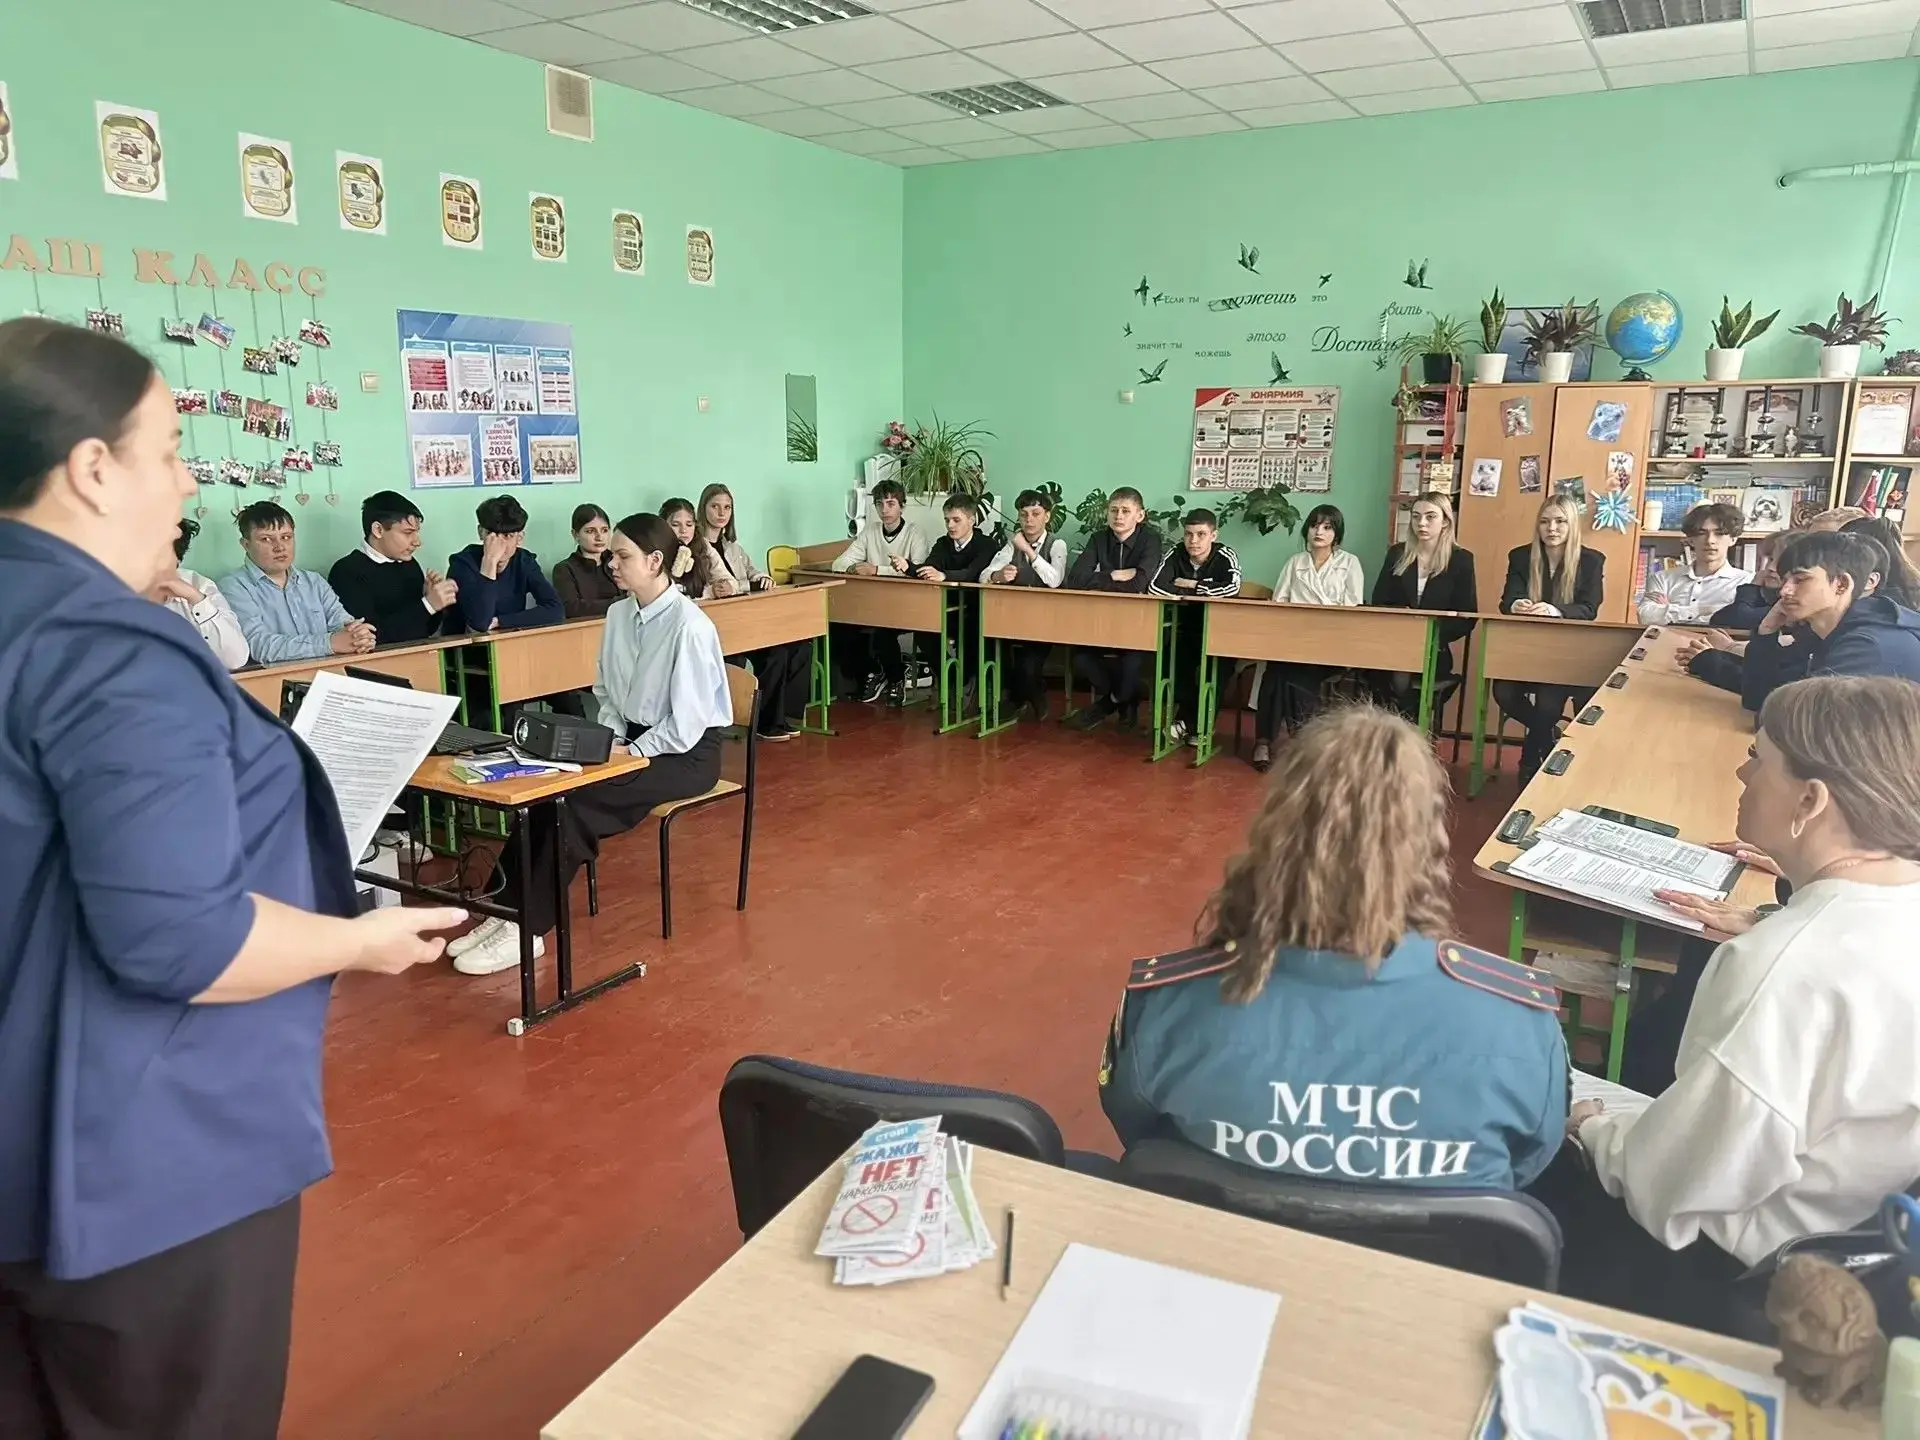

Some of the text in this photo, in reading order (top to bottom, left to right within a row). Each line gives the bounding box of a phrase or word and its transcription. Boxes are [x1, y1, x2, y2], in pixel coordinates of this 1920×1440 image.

[132, 247, 325, 297] КЛАСС
[1189, 296, 1200, 304] ты
[1194, 350, 1232, 358] можешь
[1246, 332, 1287, 342] этого
[1250, 390, 1304, 399] ЮНАРМИЯ
[489, 446, 513, 456] 2026
[1267, 1081, 1420, 1131] МЧС
[855, 1141, 920, 1163] СКАЖИ
[1210, 1120, 1476, 1179] РОССИИ
[860, 1155, 926, 1185] НЕТ
